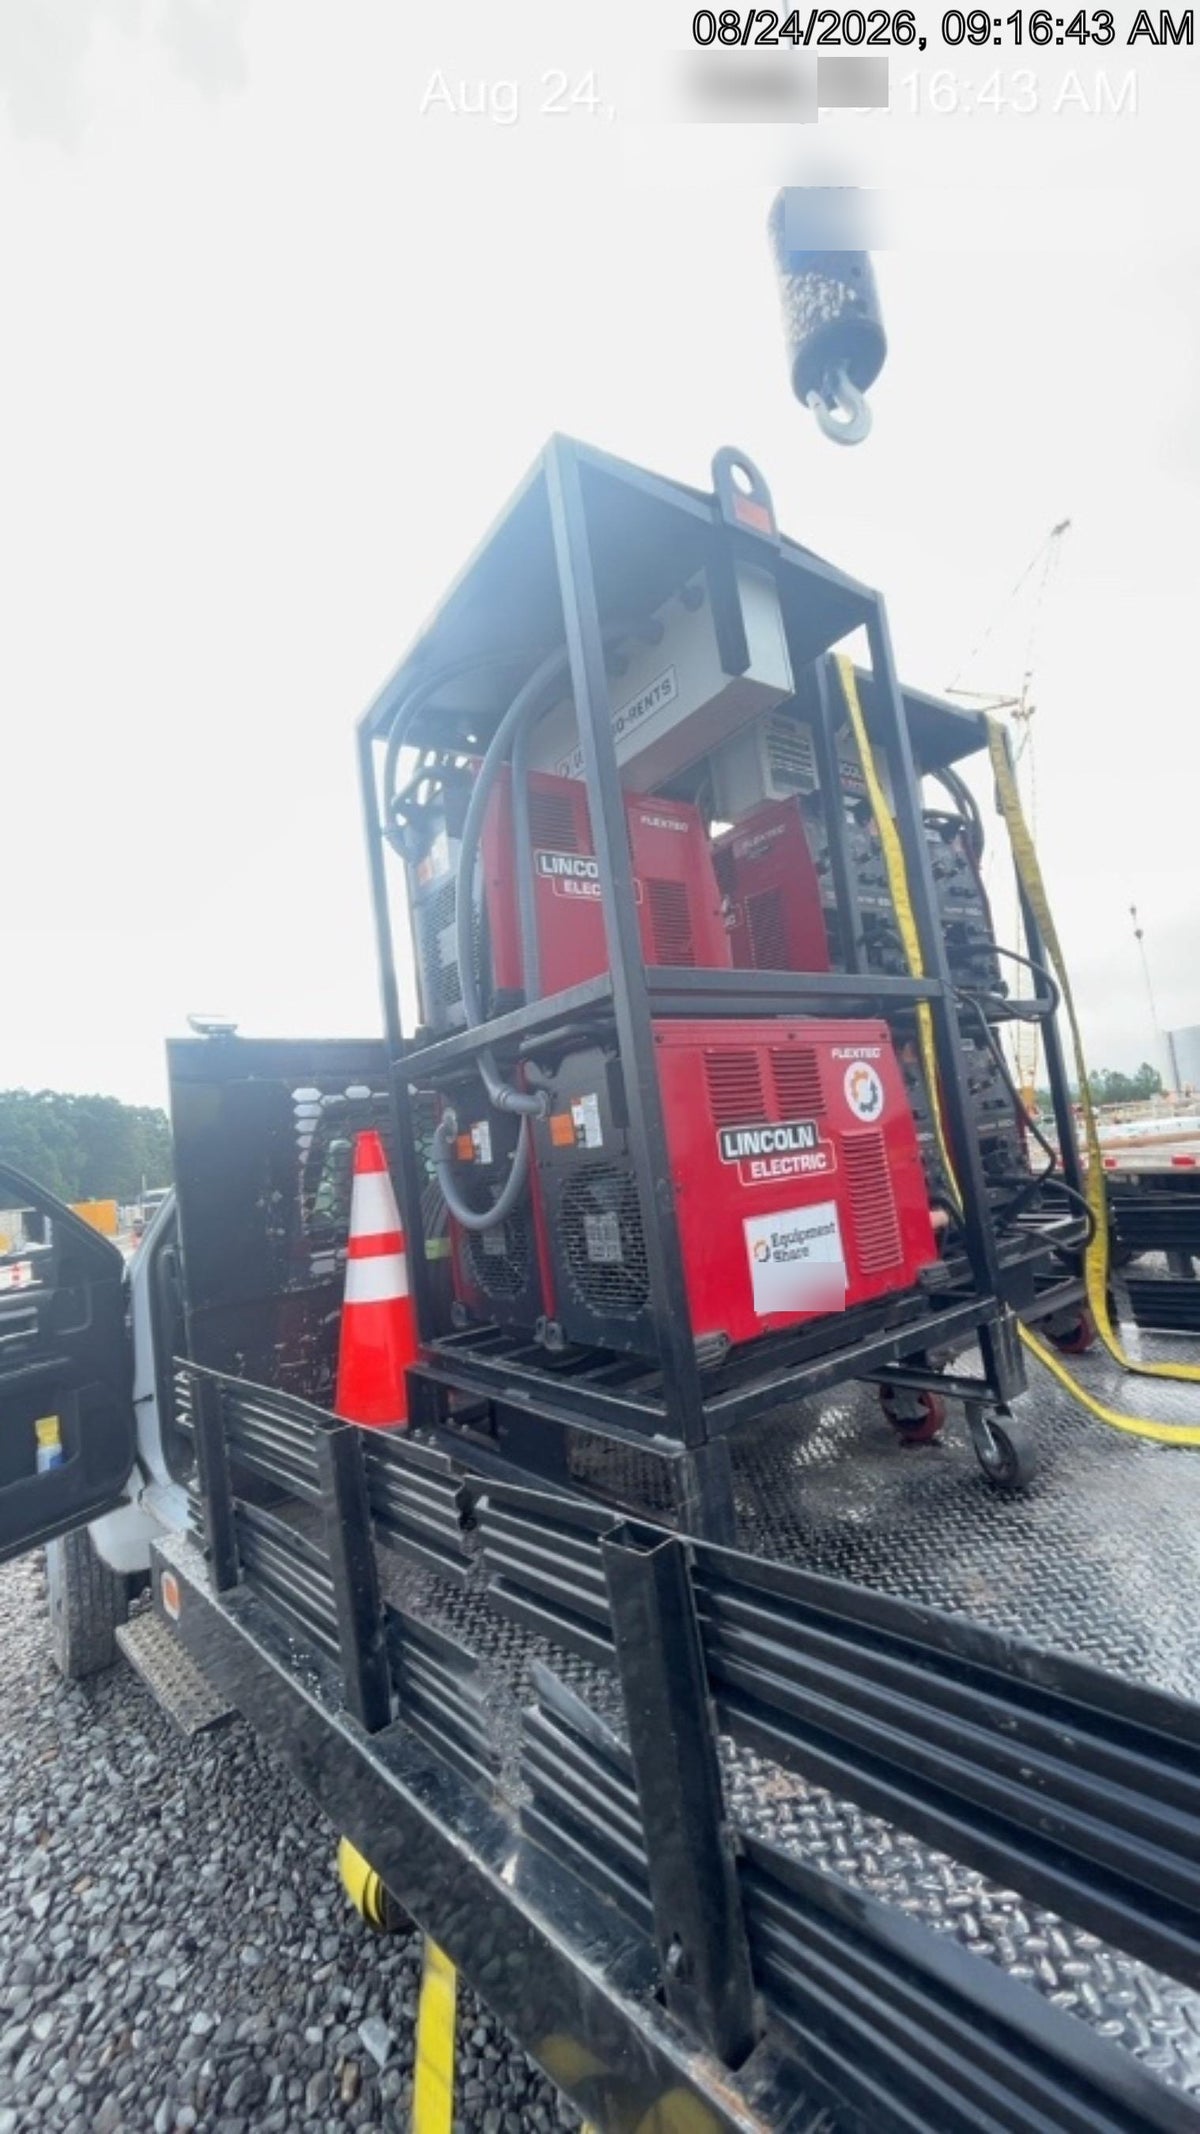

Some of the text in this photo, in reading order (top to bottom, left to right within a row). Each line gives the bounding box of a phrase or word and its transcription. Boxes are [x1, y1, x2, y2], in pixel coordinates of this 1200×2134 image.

[540, 855, 598, 879] LINCO
[563, 878, 602, 897] ELEC
[724, 1125, 815, 1158] LINCOLN
[750, 1152, 827, 1179] ELECTRIC
[770, 1221, 836, 1248] Equipment
[772, 1246, 810, 1263] Share
